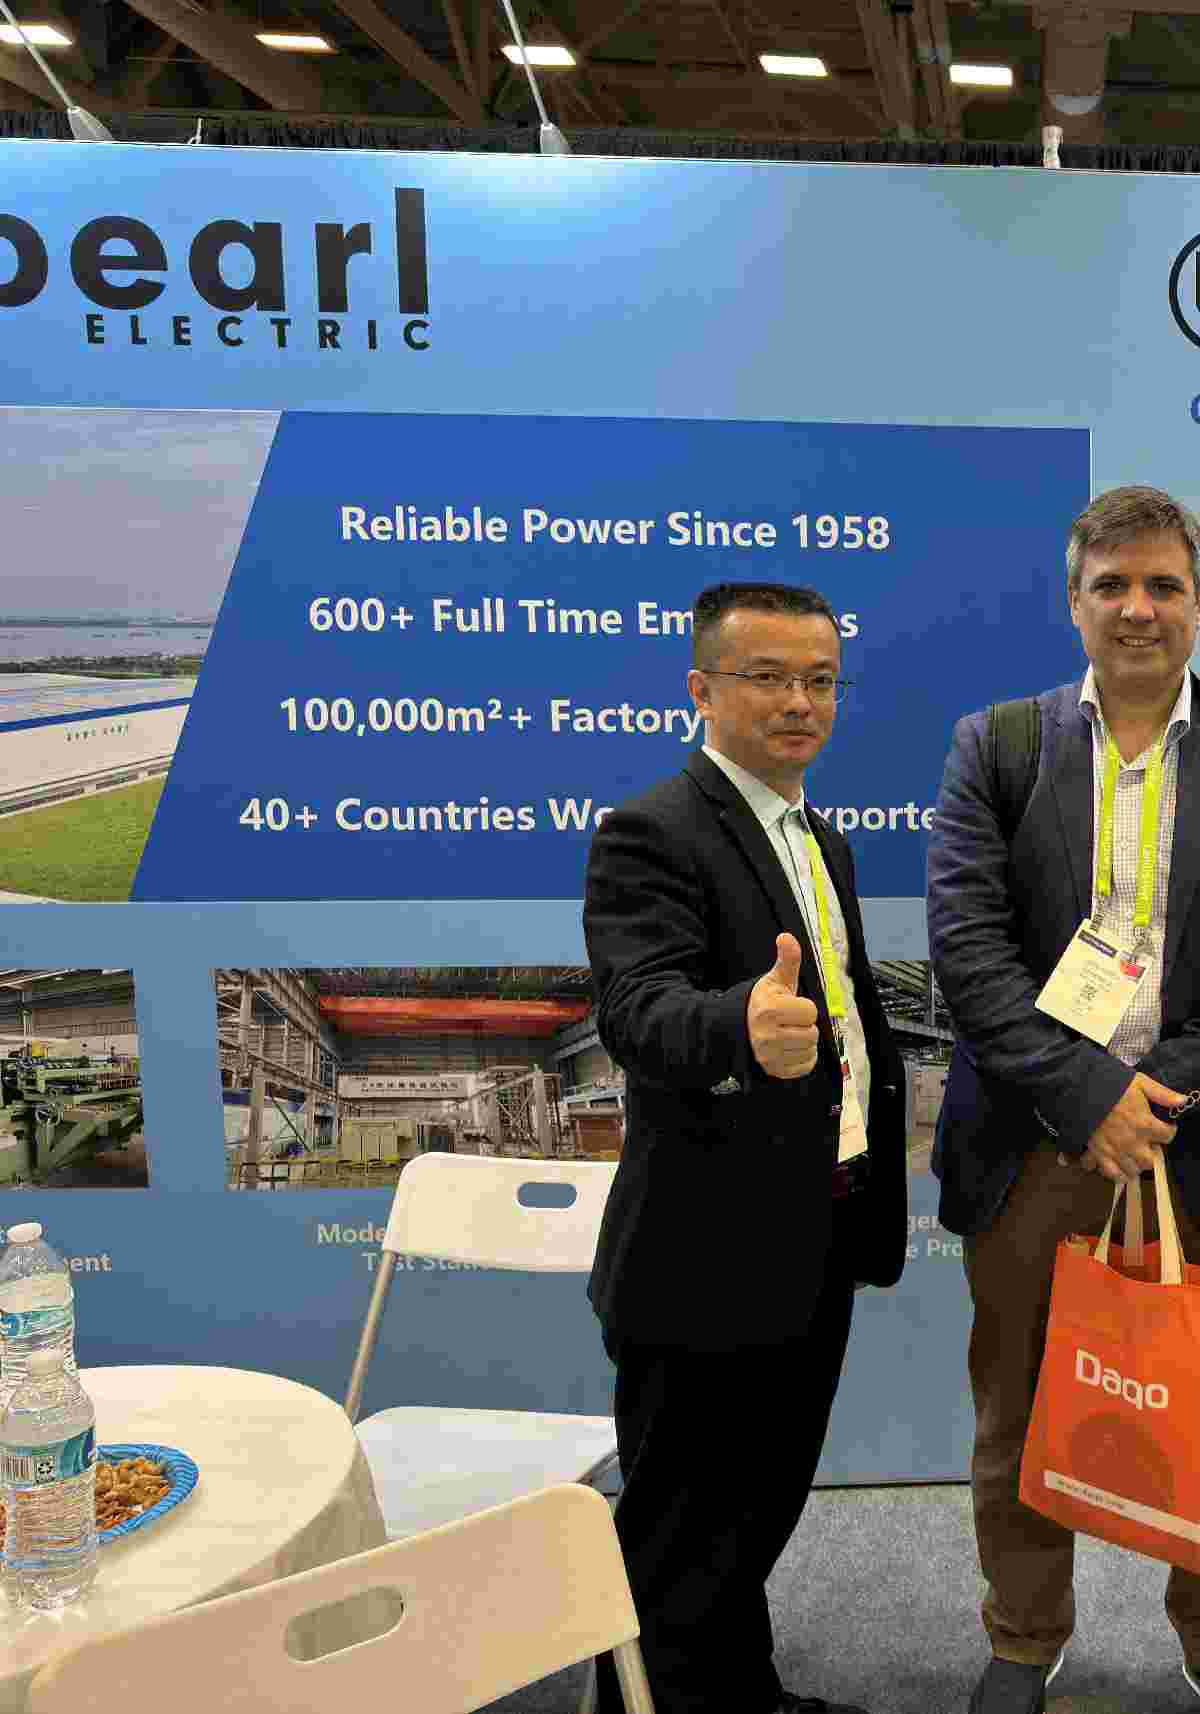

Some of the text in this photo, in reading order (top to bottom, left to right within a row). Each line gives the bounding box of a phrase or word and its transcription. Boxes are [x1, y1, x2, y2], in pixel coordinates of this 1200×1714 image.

[86, 314, 431, 350] ELECTRIC
[341, 506, 890, 550] Reliable Power Since 1958
[309, 598, 414, 633] 600+
[433, 598, 505, 633] Full
[518, 598, 623, 634] Time
[550, 698, 704, 743] Factory
[239, 798, 318, 831] 40+
[335, 796, 536, 831] Countries
[810, 802, 936, 836] xporte
[362, 1252, 416, 1271] Tst
[1075, 1348, 1169, 1411] Daqo
